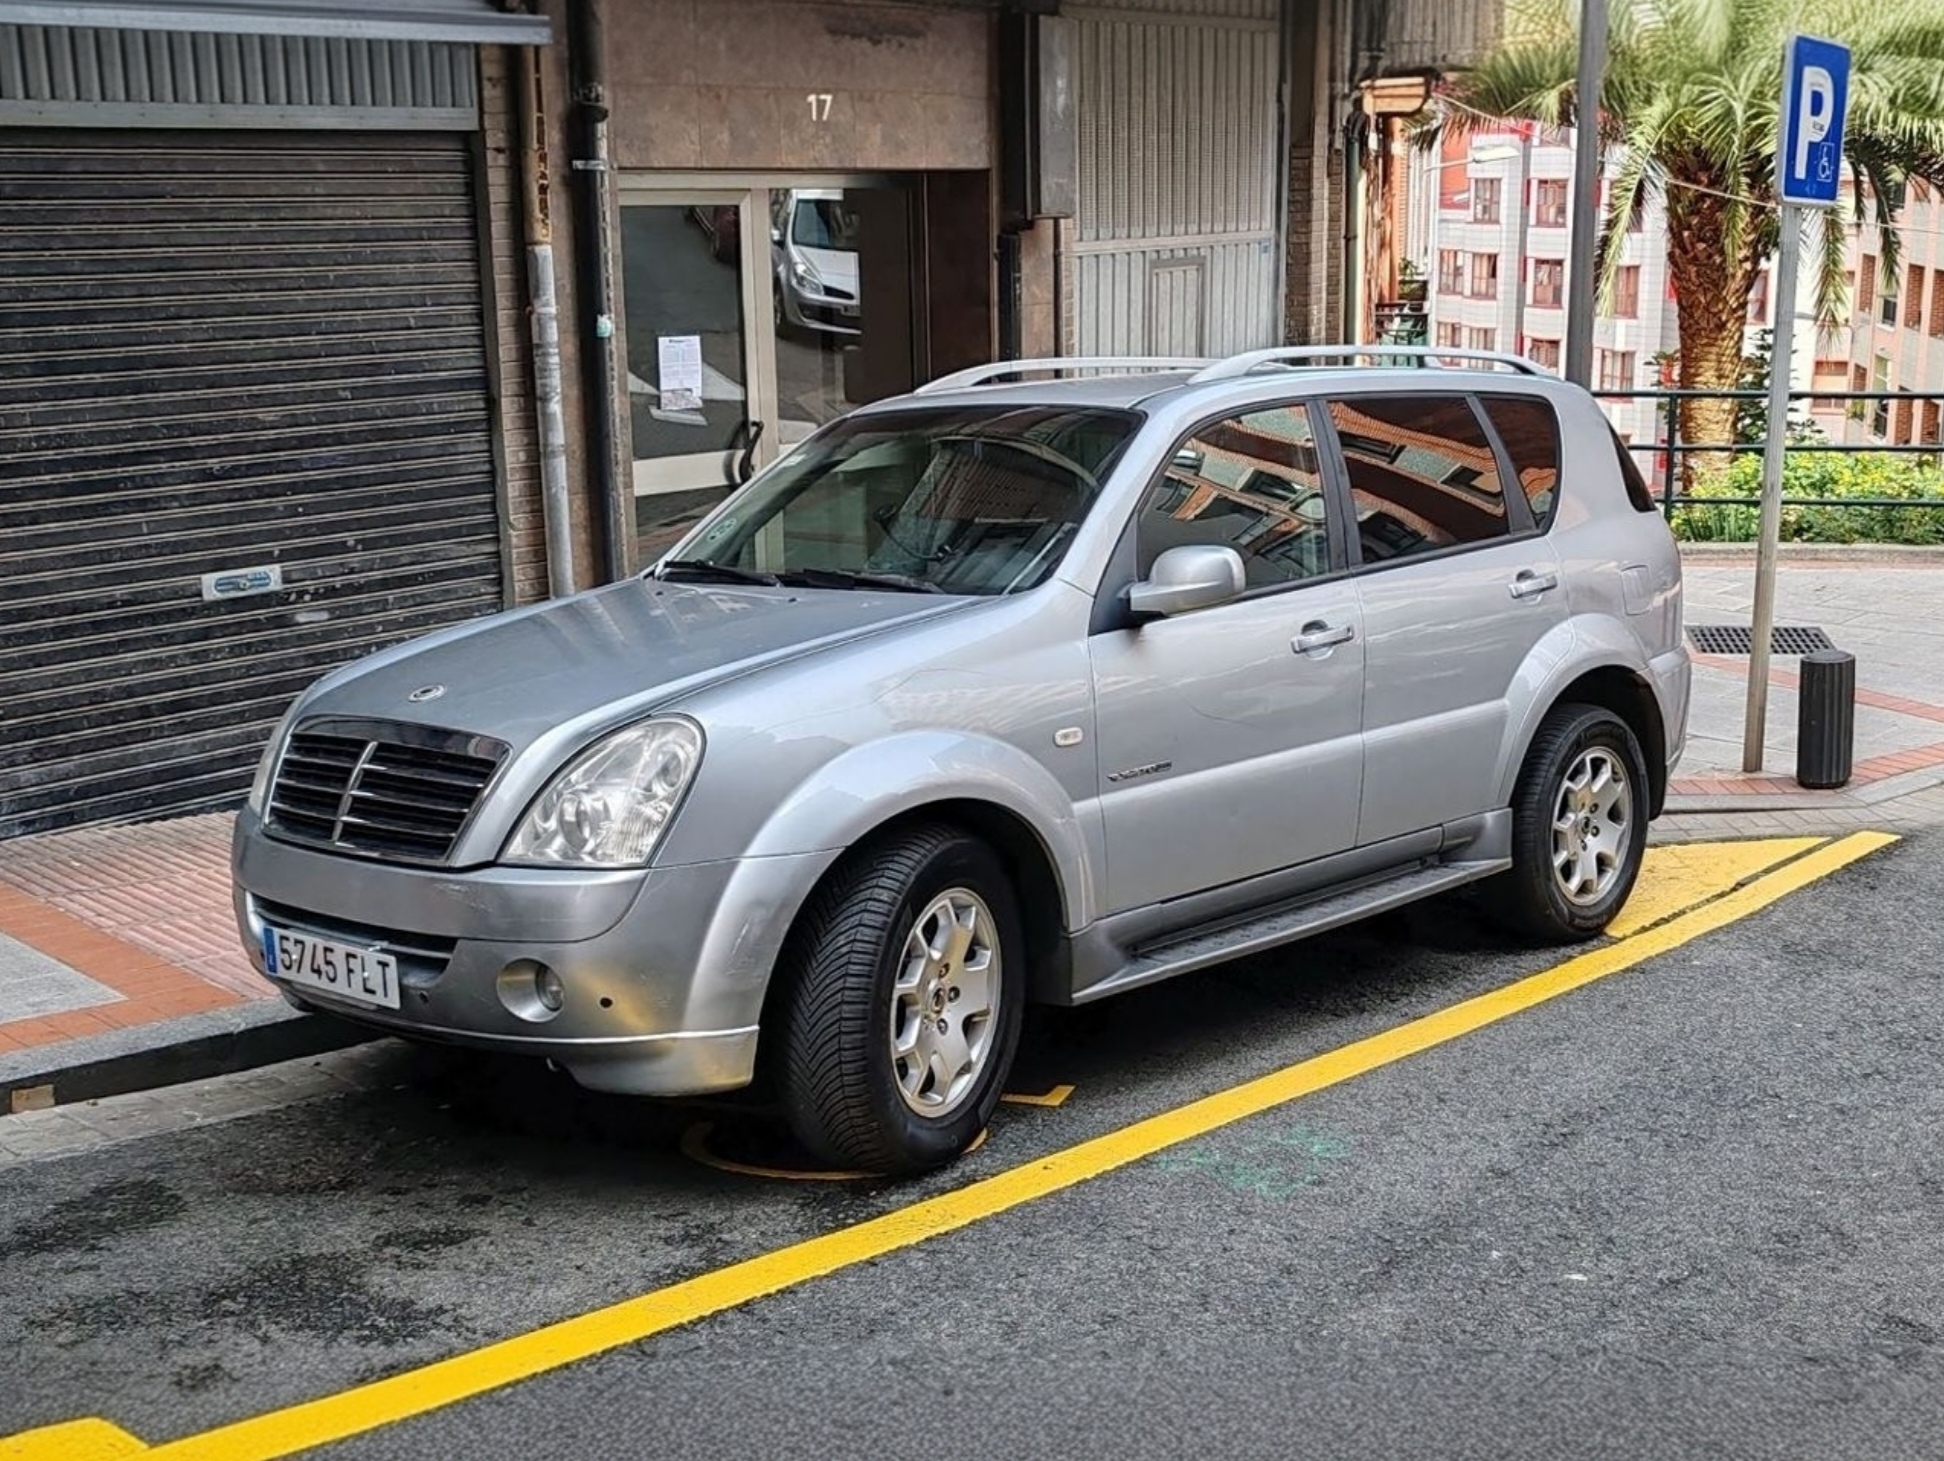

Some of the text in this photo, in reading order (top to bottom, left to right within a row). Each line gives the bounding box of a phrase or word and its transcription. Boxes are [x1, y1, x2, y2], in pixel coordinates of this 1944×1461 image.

[806, 93, 833, 121] 17
[1795, 66, 1834, 180] P
[278, 934, 391, 999] 5745 FLT
